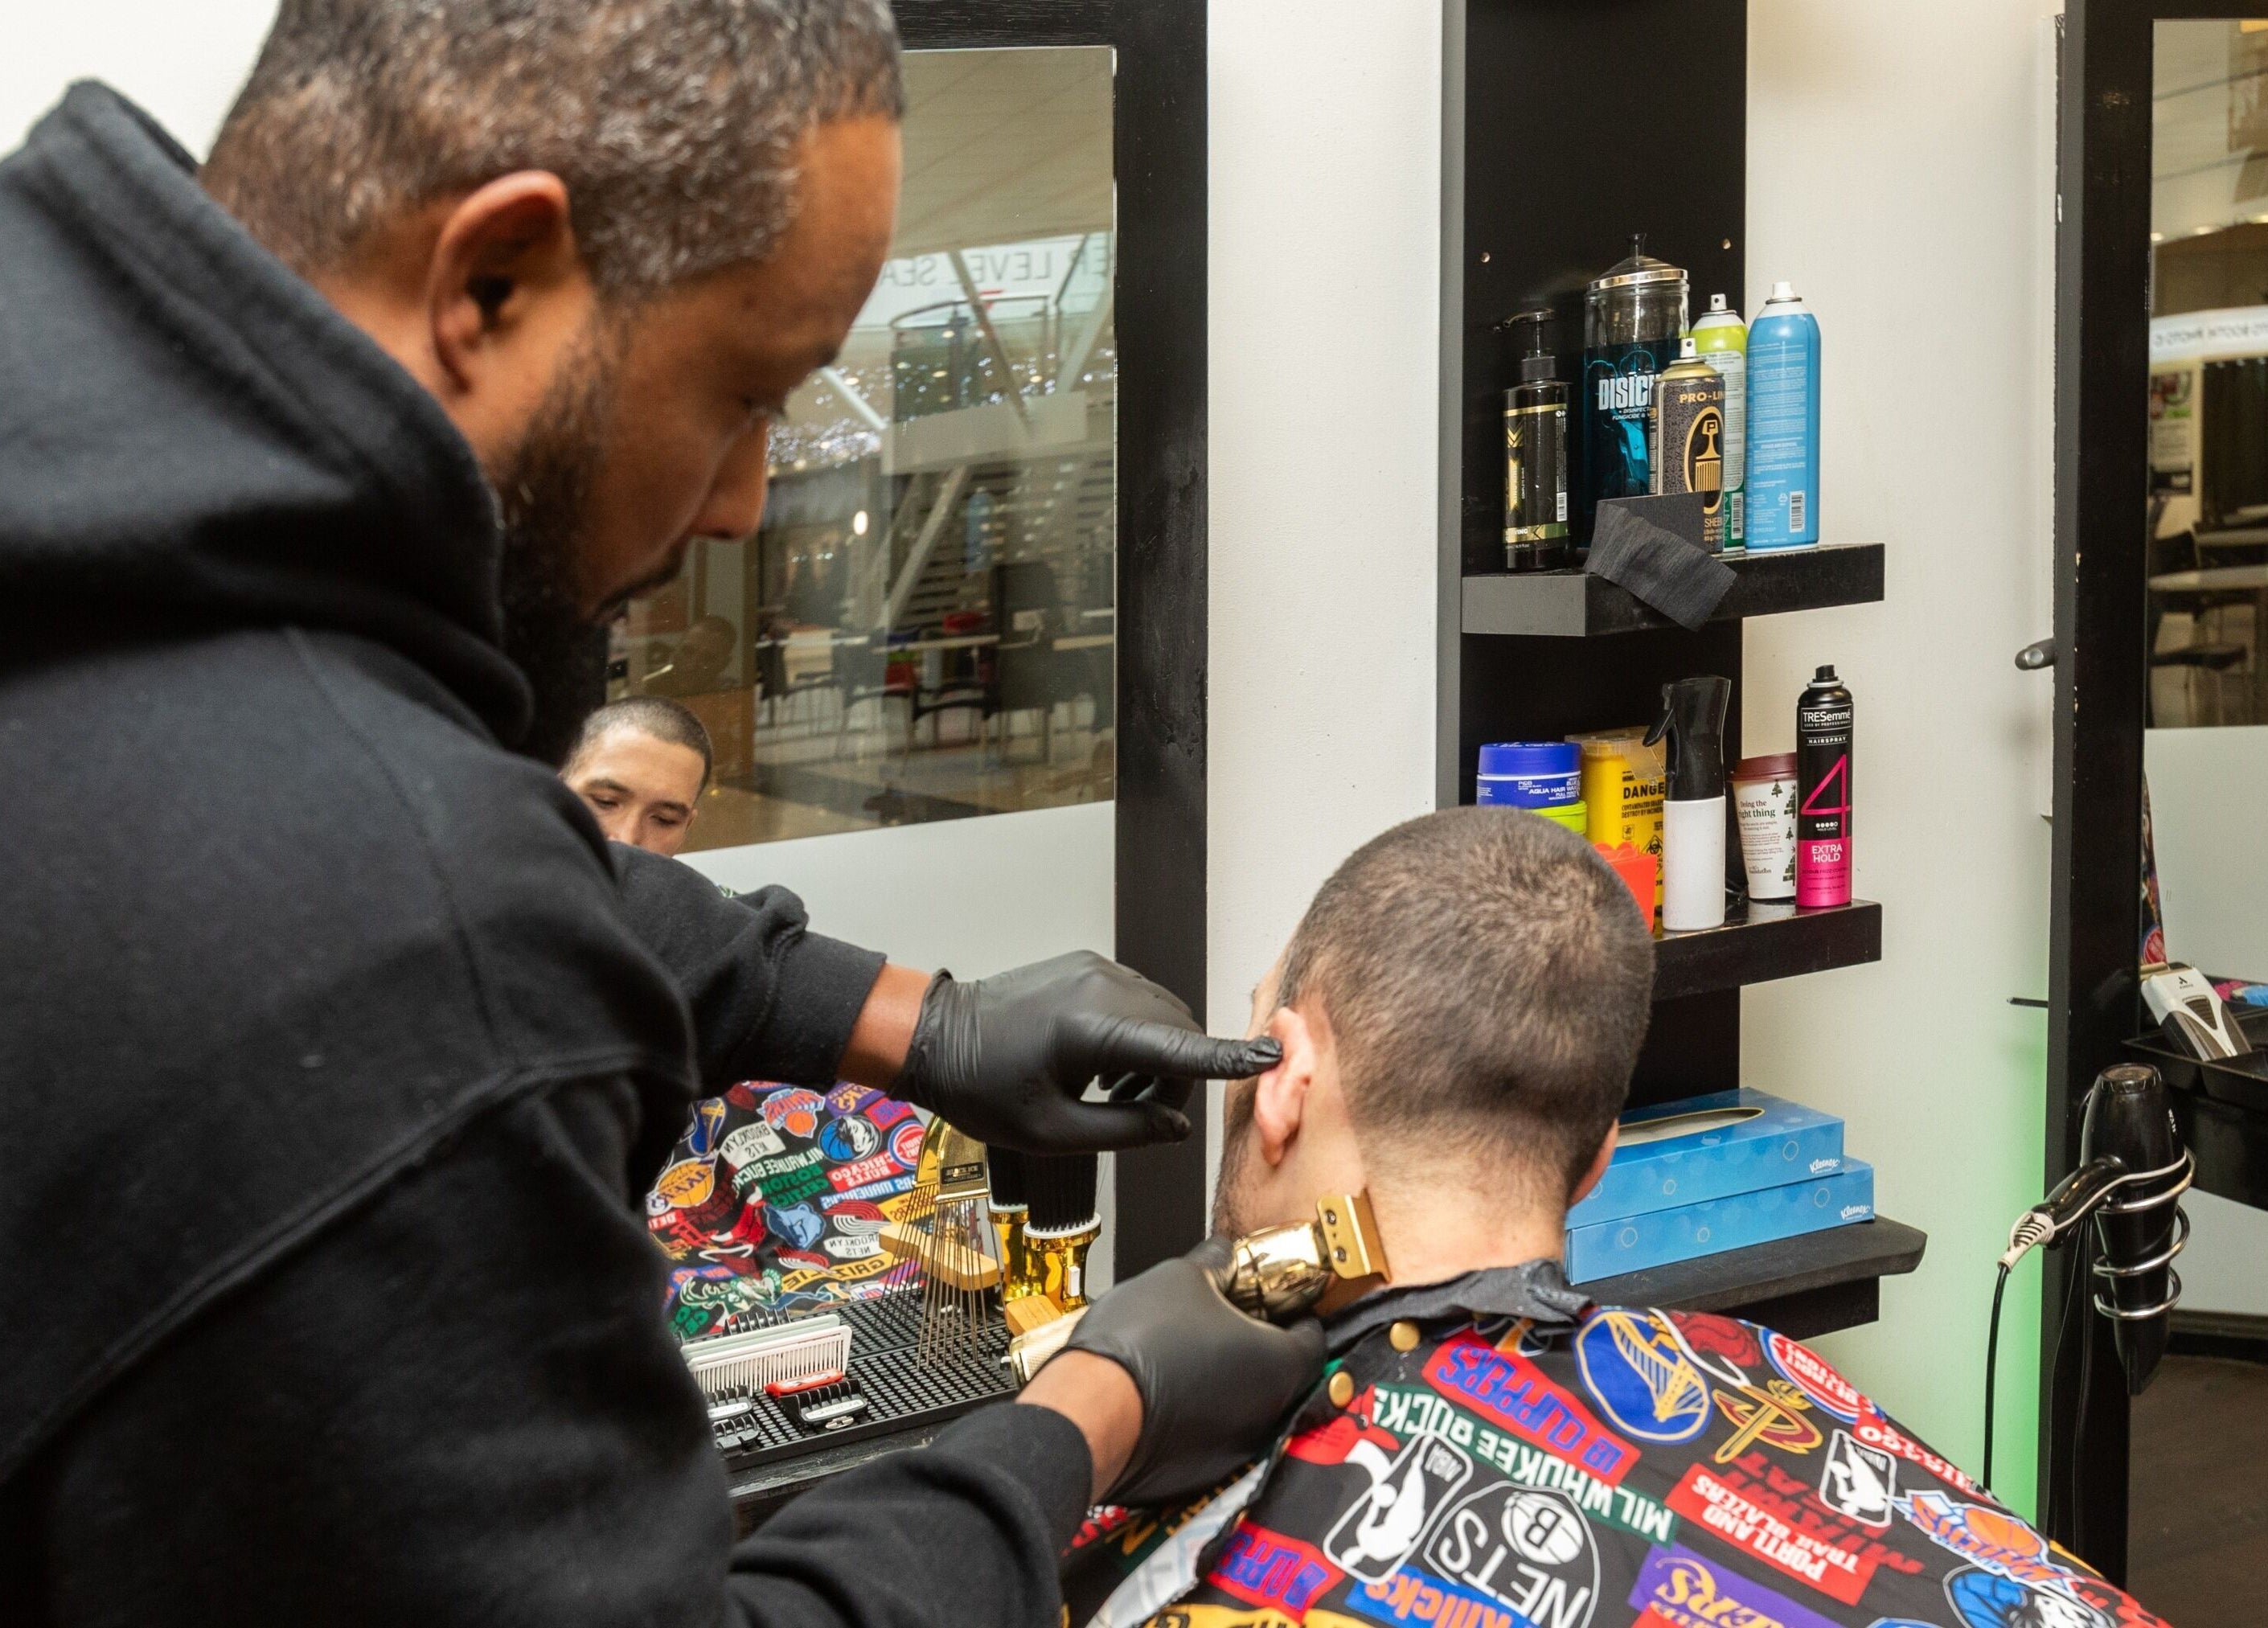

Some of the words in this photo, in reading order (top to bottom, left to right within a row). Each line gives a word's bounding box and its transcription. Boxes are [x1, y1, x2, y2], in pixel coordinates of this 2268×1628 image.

[1623, 781, 1665, 799] DANGE
[1800, 753, 1851, 841] 4
[1753, 808, 1776, 818] thing
[1812, 843, 1843, 854] EXTRA
[1813, 853, 1841, 863] HOLD
[1810, 1158, 1840, 1173] Kleenex
[1840, 1205, 1871, 1220] Kleenex
[1436, 1343, 1588, 1453] CLIPPERS
[1424, 1445, 1462, 1482] NBA
[1691, 1474, 1792, 1542] BLAZERS
[1702, 1503, 1828, 1584] PORTLAND
[1794, 1533, 1860, 1575] TRAIL
[1437, 1508, 1592, 1628] NETS
